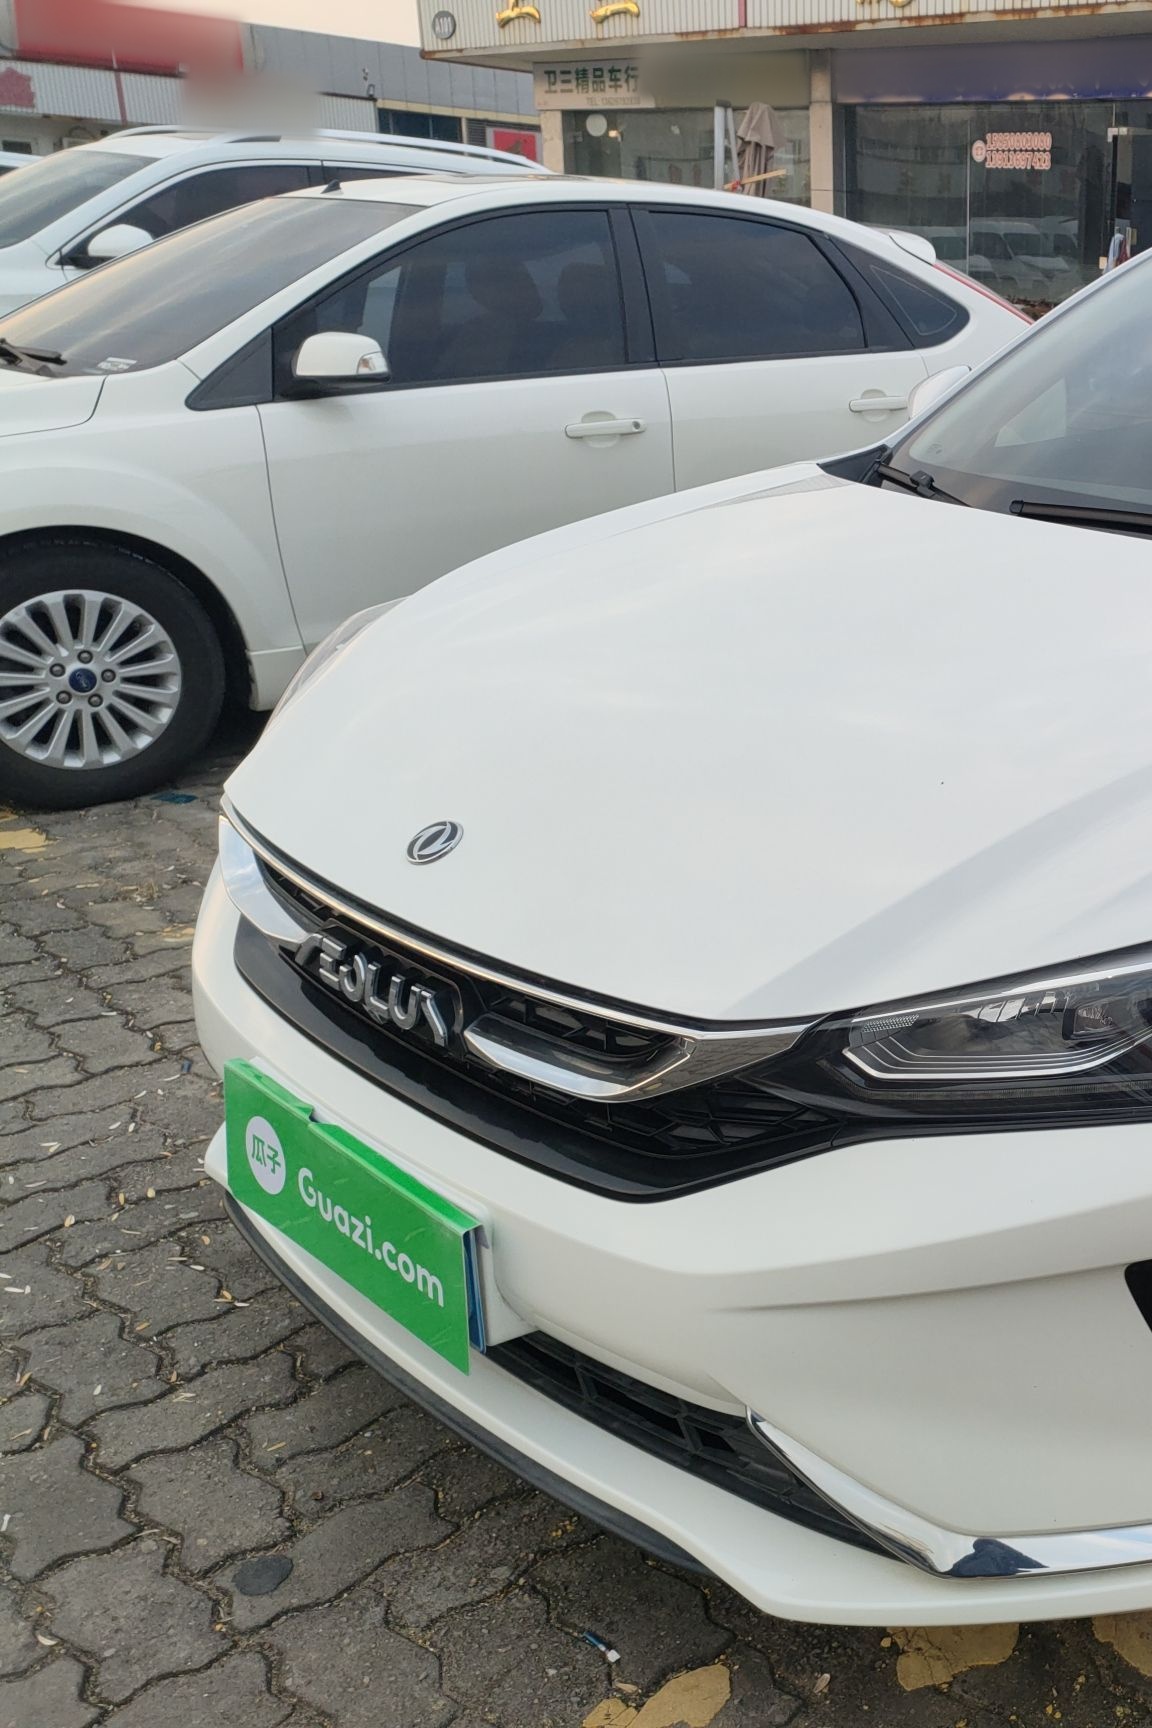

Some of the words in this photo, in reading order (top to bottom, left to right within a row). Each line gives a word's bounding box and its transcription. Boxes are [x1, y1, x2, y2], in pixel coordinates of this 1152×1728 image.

[543, 65, 639, 94] 卫三精品车行
[250, 1130, 283, 1175] 瓜子
[297, 1166, 446, 1308] Guazi.com
